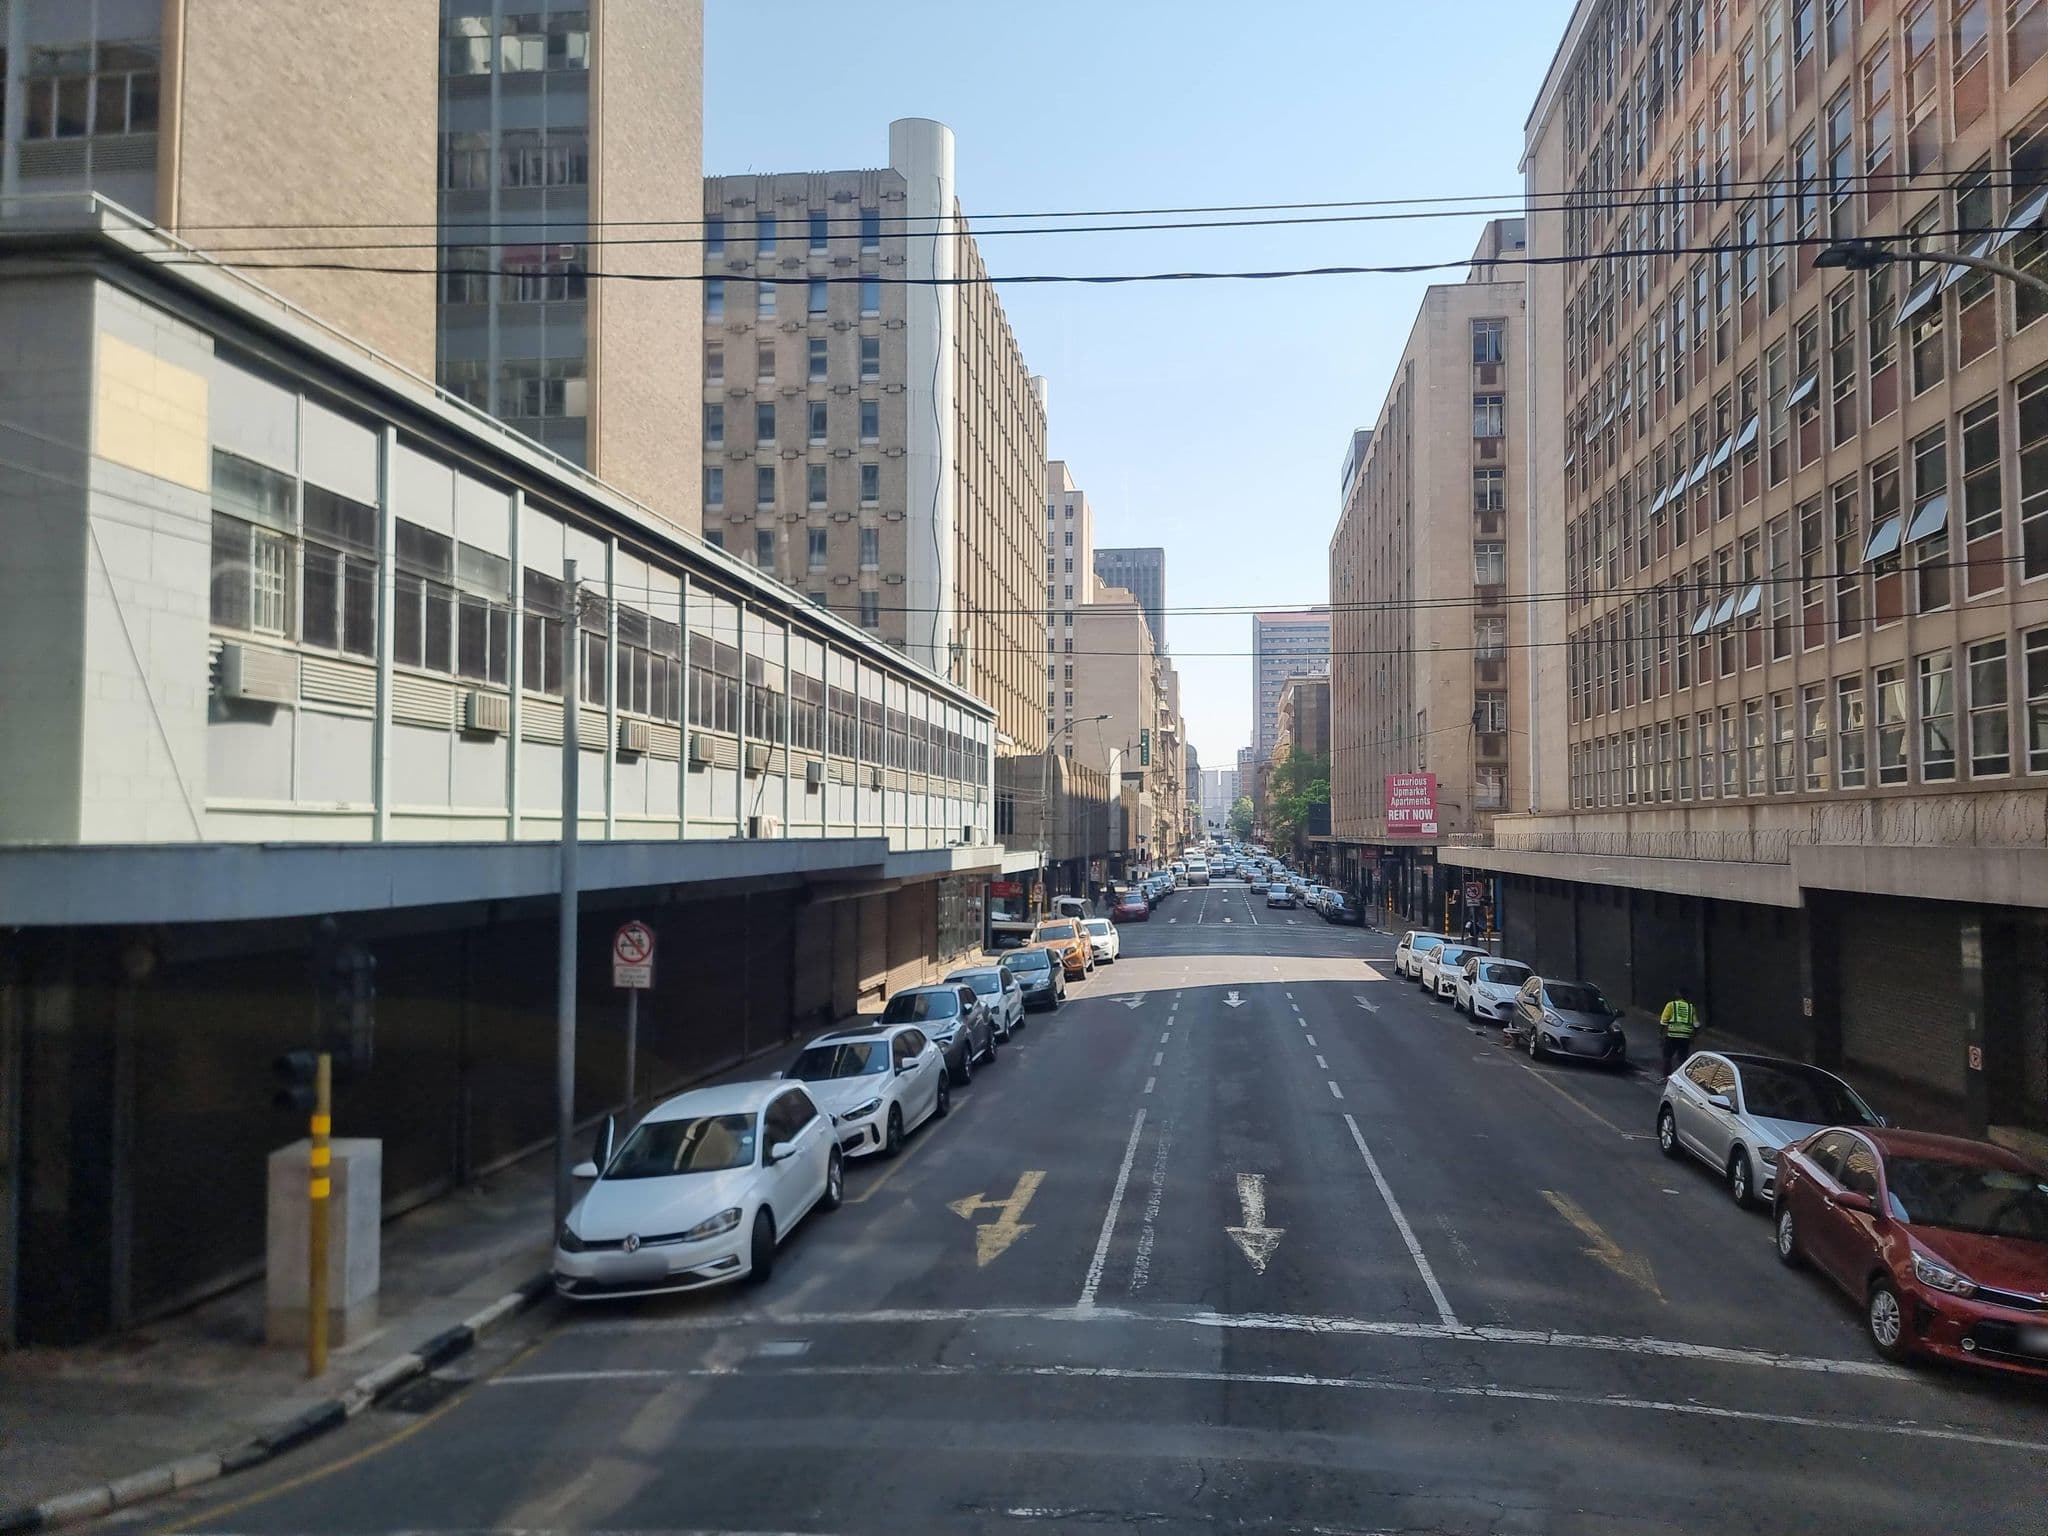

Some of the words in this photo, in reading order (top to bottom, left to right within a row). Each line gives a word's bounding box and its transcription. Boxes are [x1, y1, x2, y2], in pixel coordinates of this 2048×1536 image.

[1393, 777, 1427, 786] Luxurious
[1393, 787, 1427, 797] Upmarket
[1391, 797, 1431, 807] Apartments
[1388, 809, 1410, 820] RENT
[1412, 809, 1433, 820] NOW
